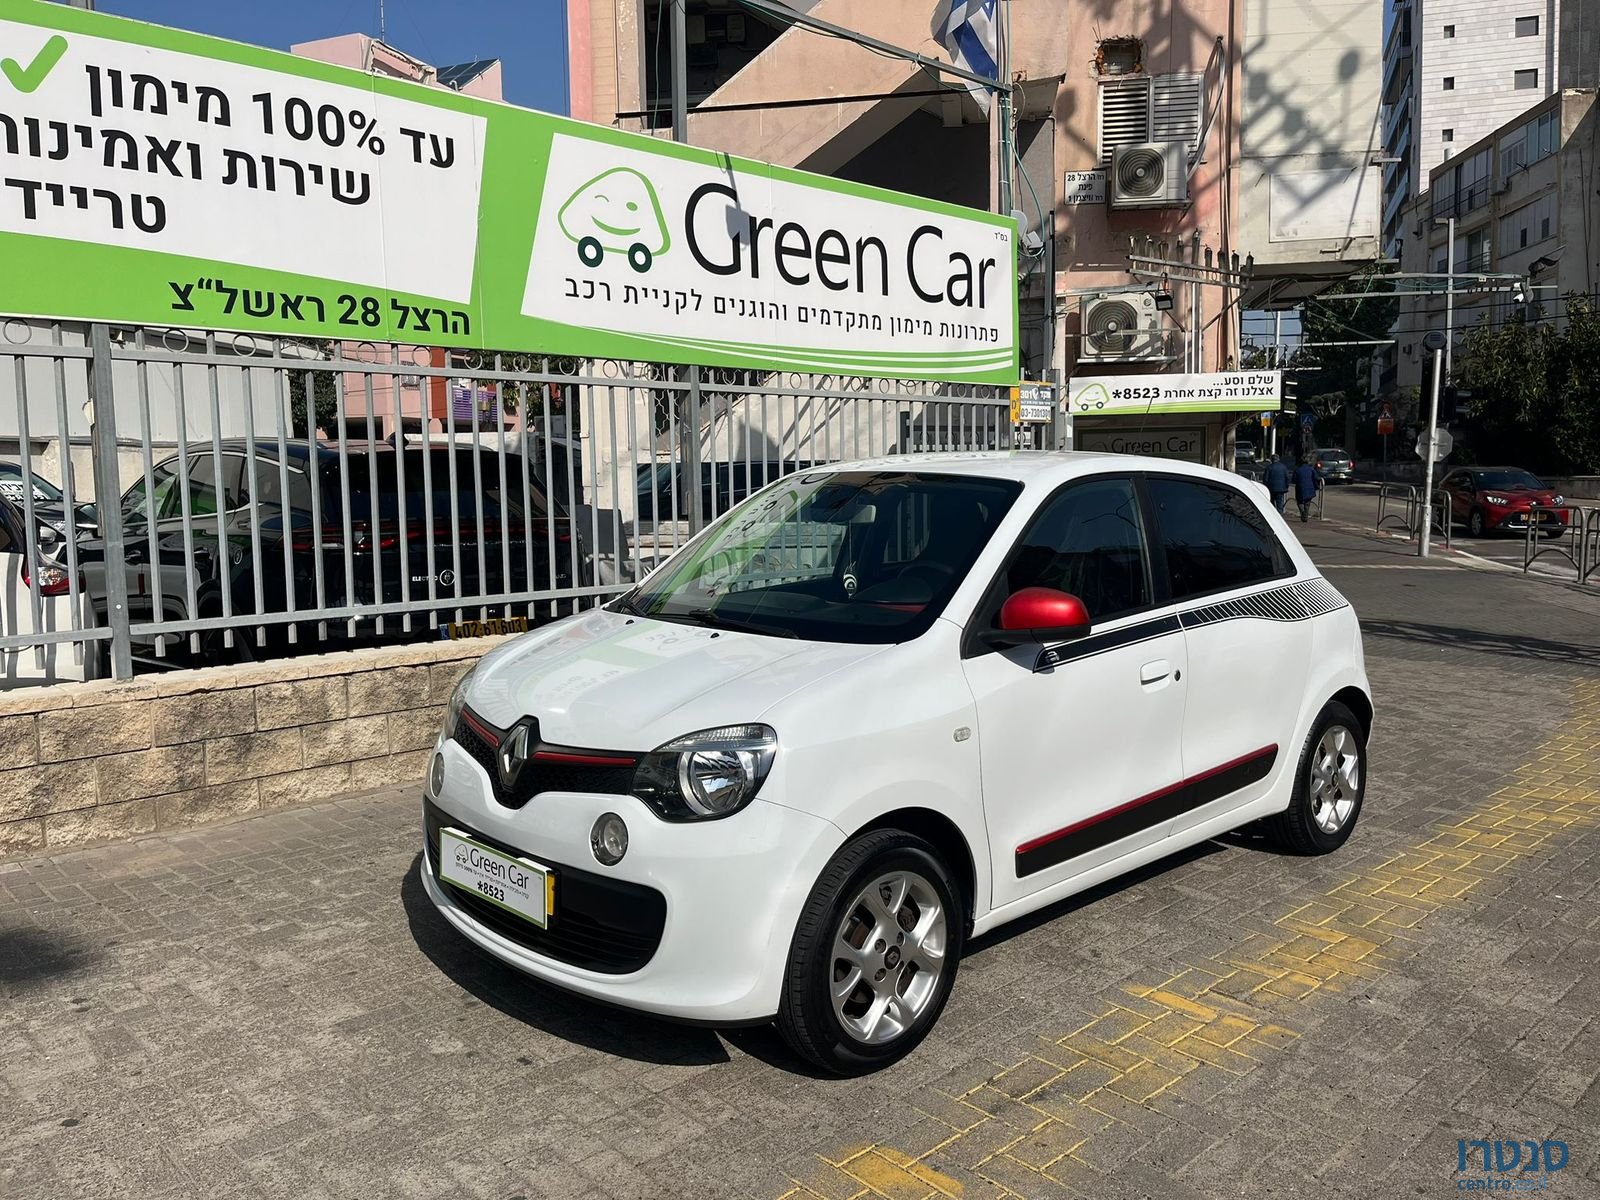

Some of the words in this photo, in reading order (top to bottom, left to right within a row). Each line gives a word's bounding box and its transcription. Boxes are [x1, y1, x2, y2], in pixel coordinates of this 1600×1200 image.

[85, 64, 231, 127] מימון
[252, 92, 385, 156] 100%
[400, 127, 454, 168] עד
[222, 148, 371, 205] שירות
[1067, 174, 1076, 182] 28
[1077, 172, 1096, 181] הרצל
[1078, 183, 1093, 191] פינת
[5, 177, 167, 234] טרייד
[684, 182, 889, 297] Green
[906, 224, 996, 309] Car
[565, 278, 611, 301] רכב
[623, 285, 702, 315] לקניית
[337, 294, 380, 326] 28
[391, 298, 470, 336] הרצל
[713, 296, 787, 321] והוגנים
[798, 306, 882, 333] מתקדמים
[890, 316, 933, 337] מימון
[939, 321, 999, 343] פתרונות
[1225, 388, 1239, 396] זה
[1241, 385, 1274, 397] אצלנו
[1248, 374, 1274, 386] שלם
[1164, 389, 1195, 399] אחרת
[1198, 388, 1222, 400] קצת
[1111, 438, 1162, 454] Green
[1167, 436, 1197, 452] Car
[470, 848, 505, 880] Green
[508, 864, 529, 889] Car
